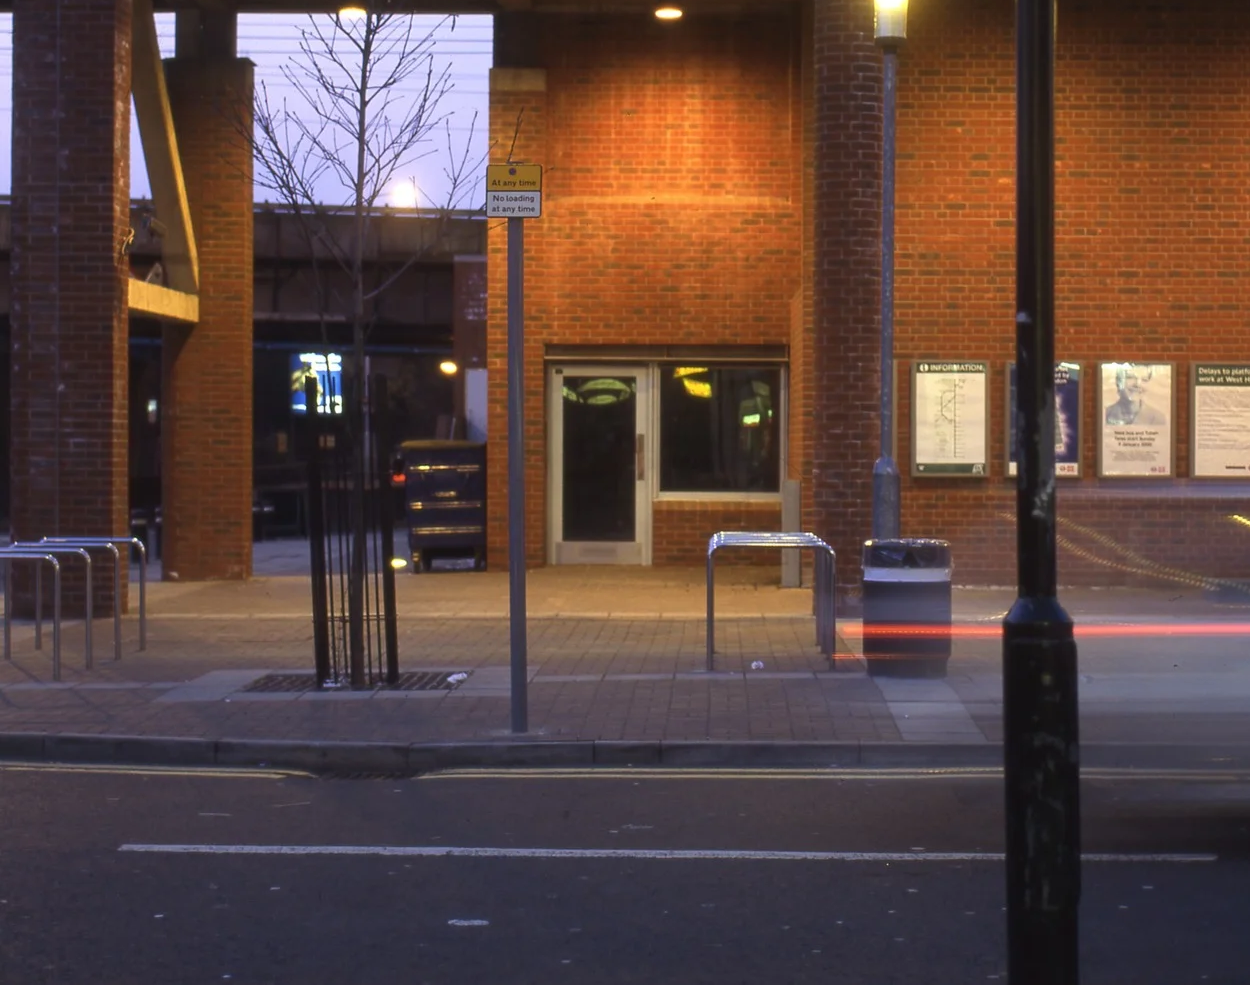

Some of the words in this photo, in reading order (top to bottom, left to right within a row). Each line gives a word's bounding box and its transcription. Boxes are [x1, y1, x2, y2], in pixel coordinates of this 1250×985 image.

[506, 195, 535, 203] loading
[930, 363, 983, 372] INFORMATION
[1198, 366, 1221, 376] Delays
[1222, 367, 1231, 375] to
[1198, 375, 1214, 383] work
[1224, 375, 1243, 383] West
